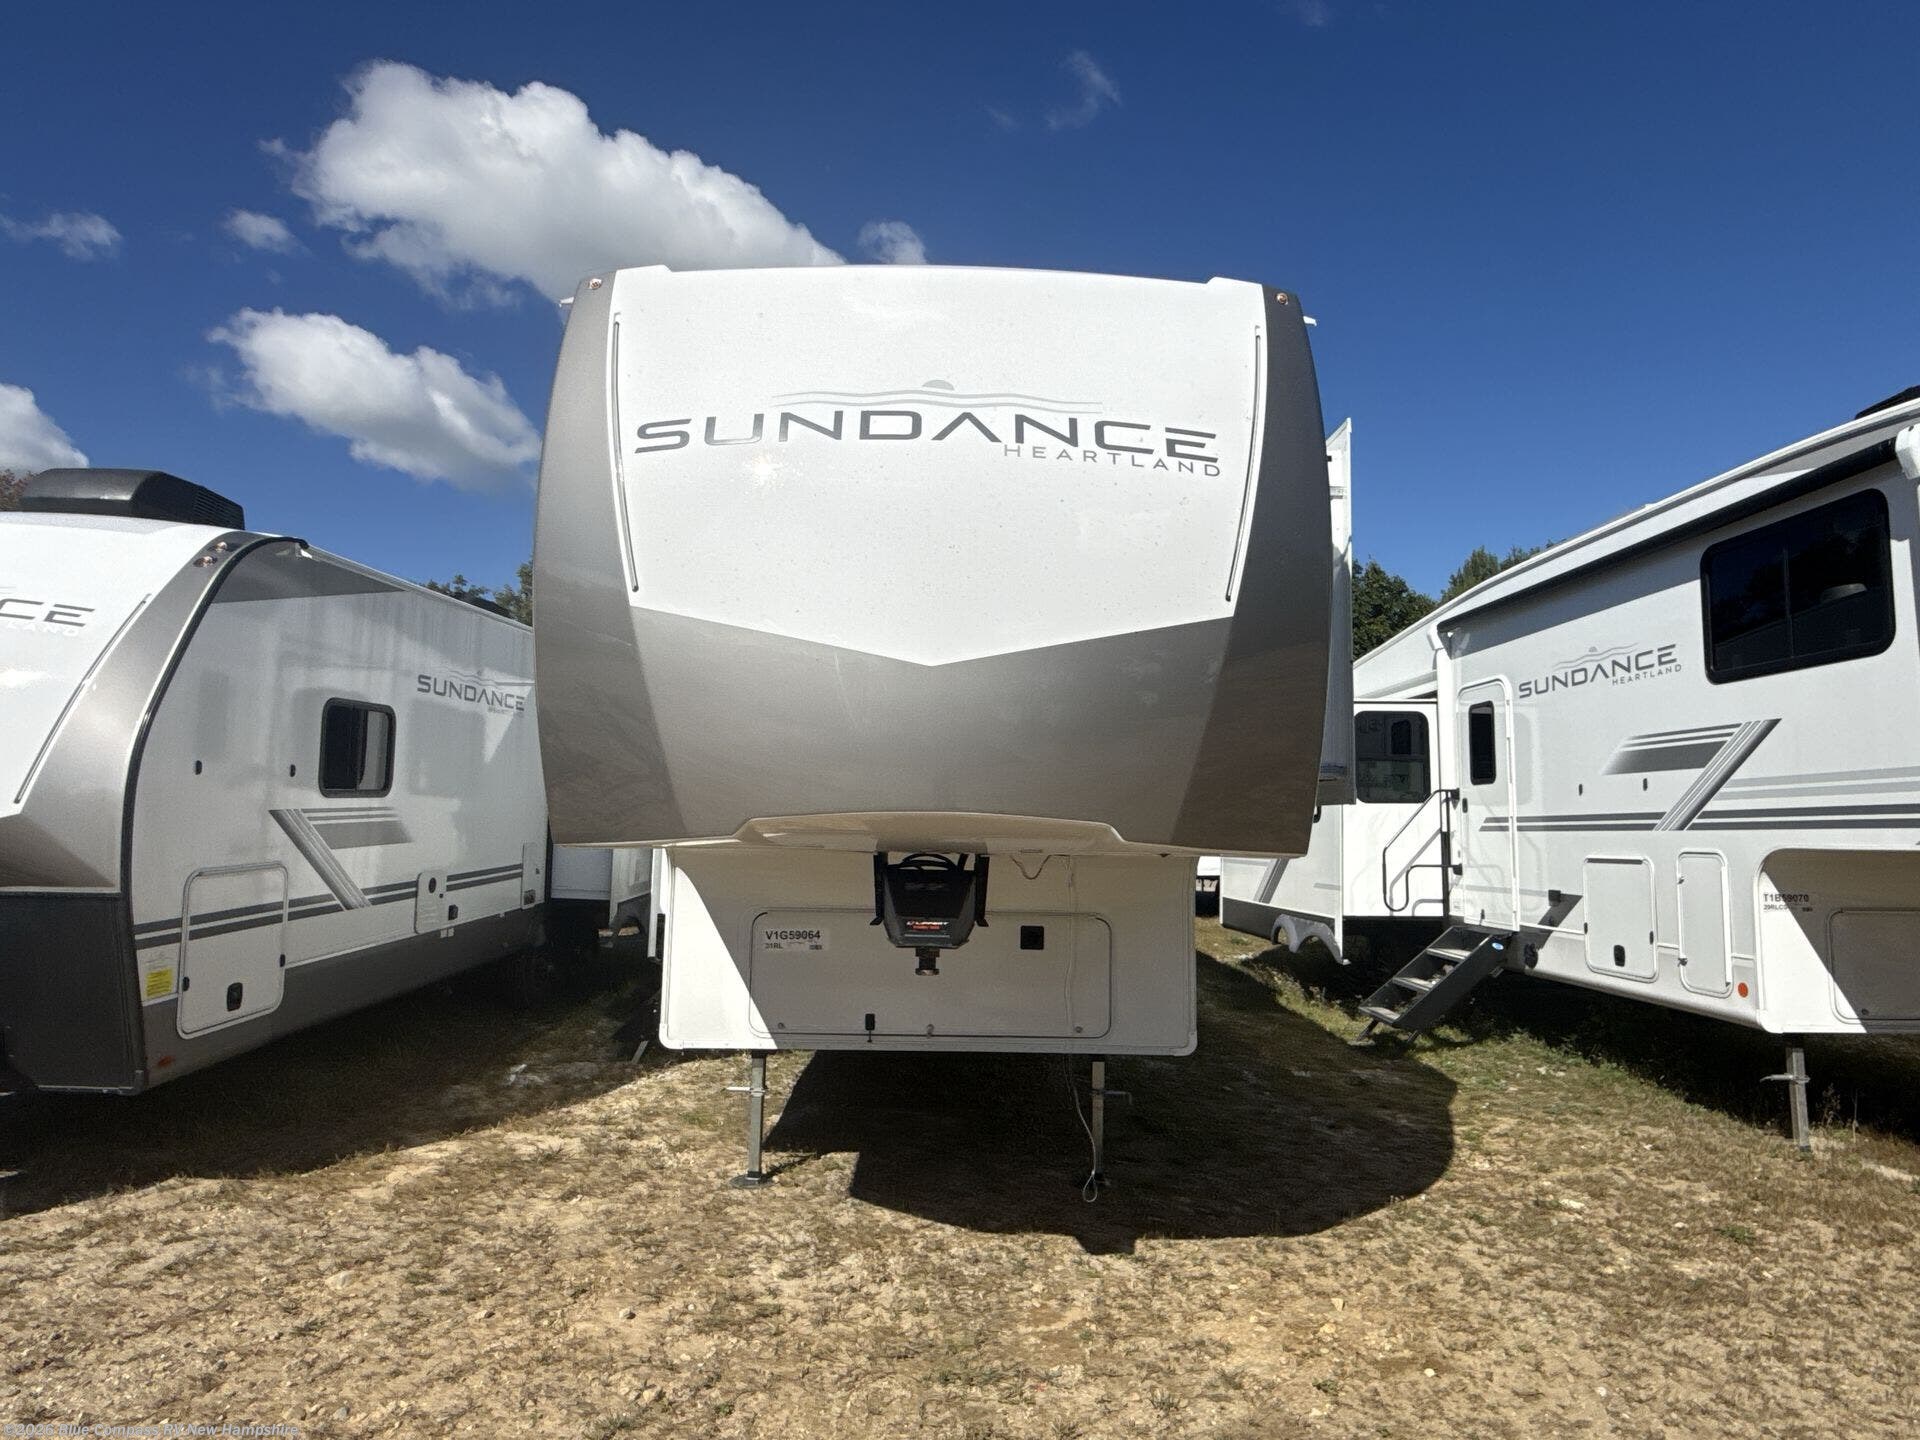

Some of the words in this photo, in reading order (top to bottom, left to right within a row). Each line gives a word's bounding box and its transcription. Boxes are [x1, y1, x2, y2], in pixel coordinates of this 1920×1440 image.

[634, 410, 1219, 463] SUNDANCE
[1004, 444, 1221, 477] HEARTLAND
[1518, 643, 1677, 699] SUNDANCE
[1612, 664, 1682, 686] HEARTLAND
[417, 674, 525, 712] SUNDANCE
[765, 930, 821, 940] V1G59064
